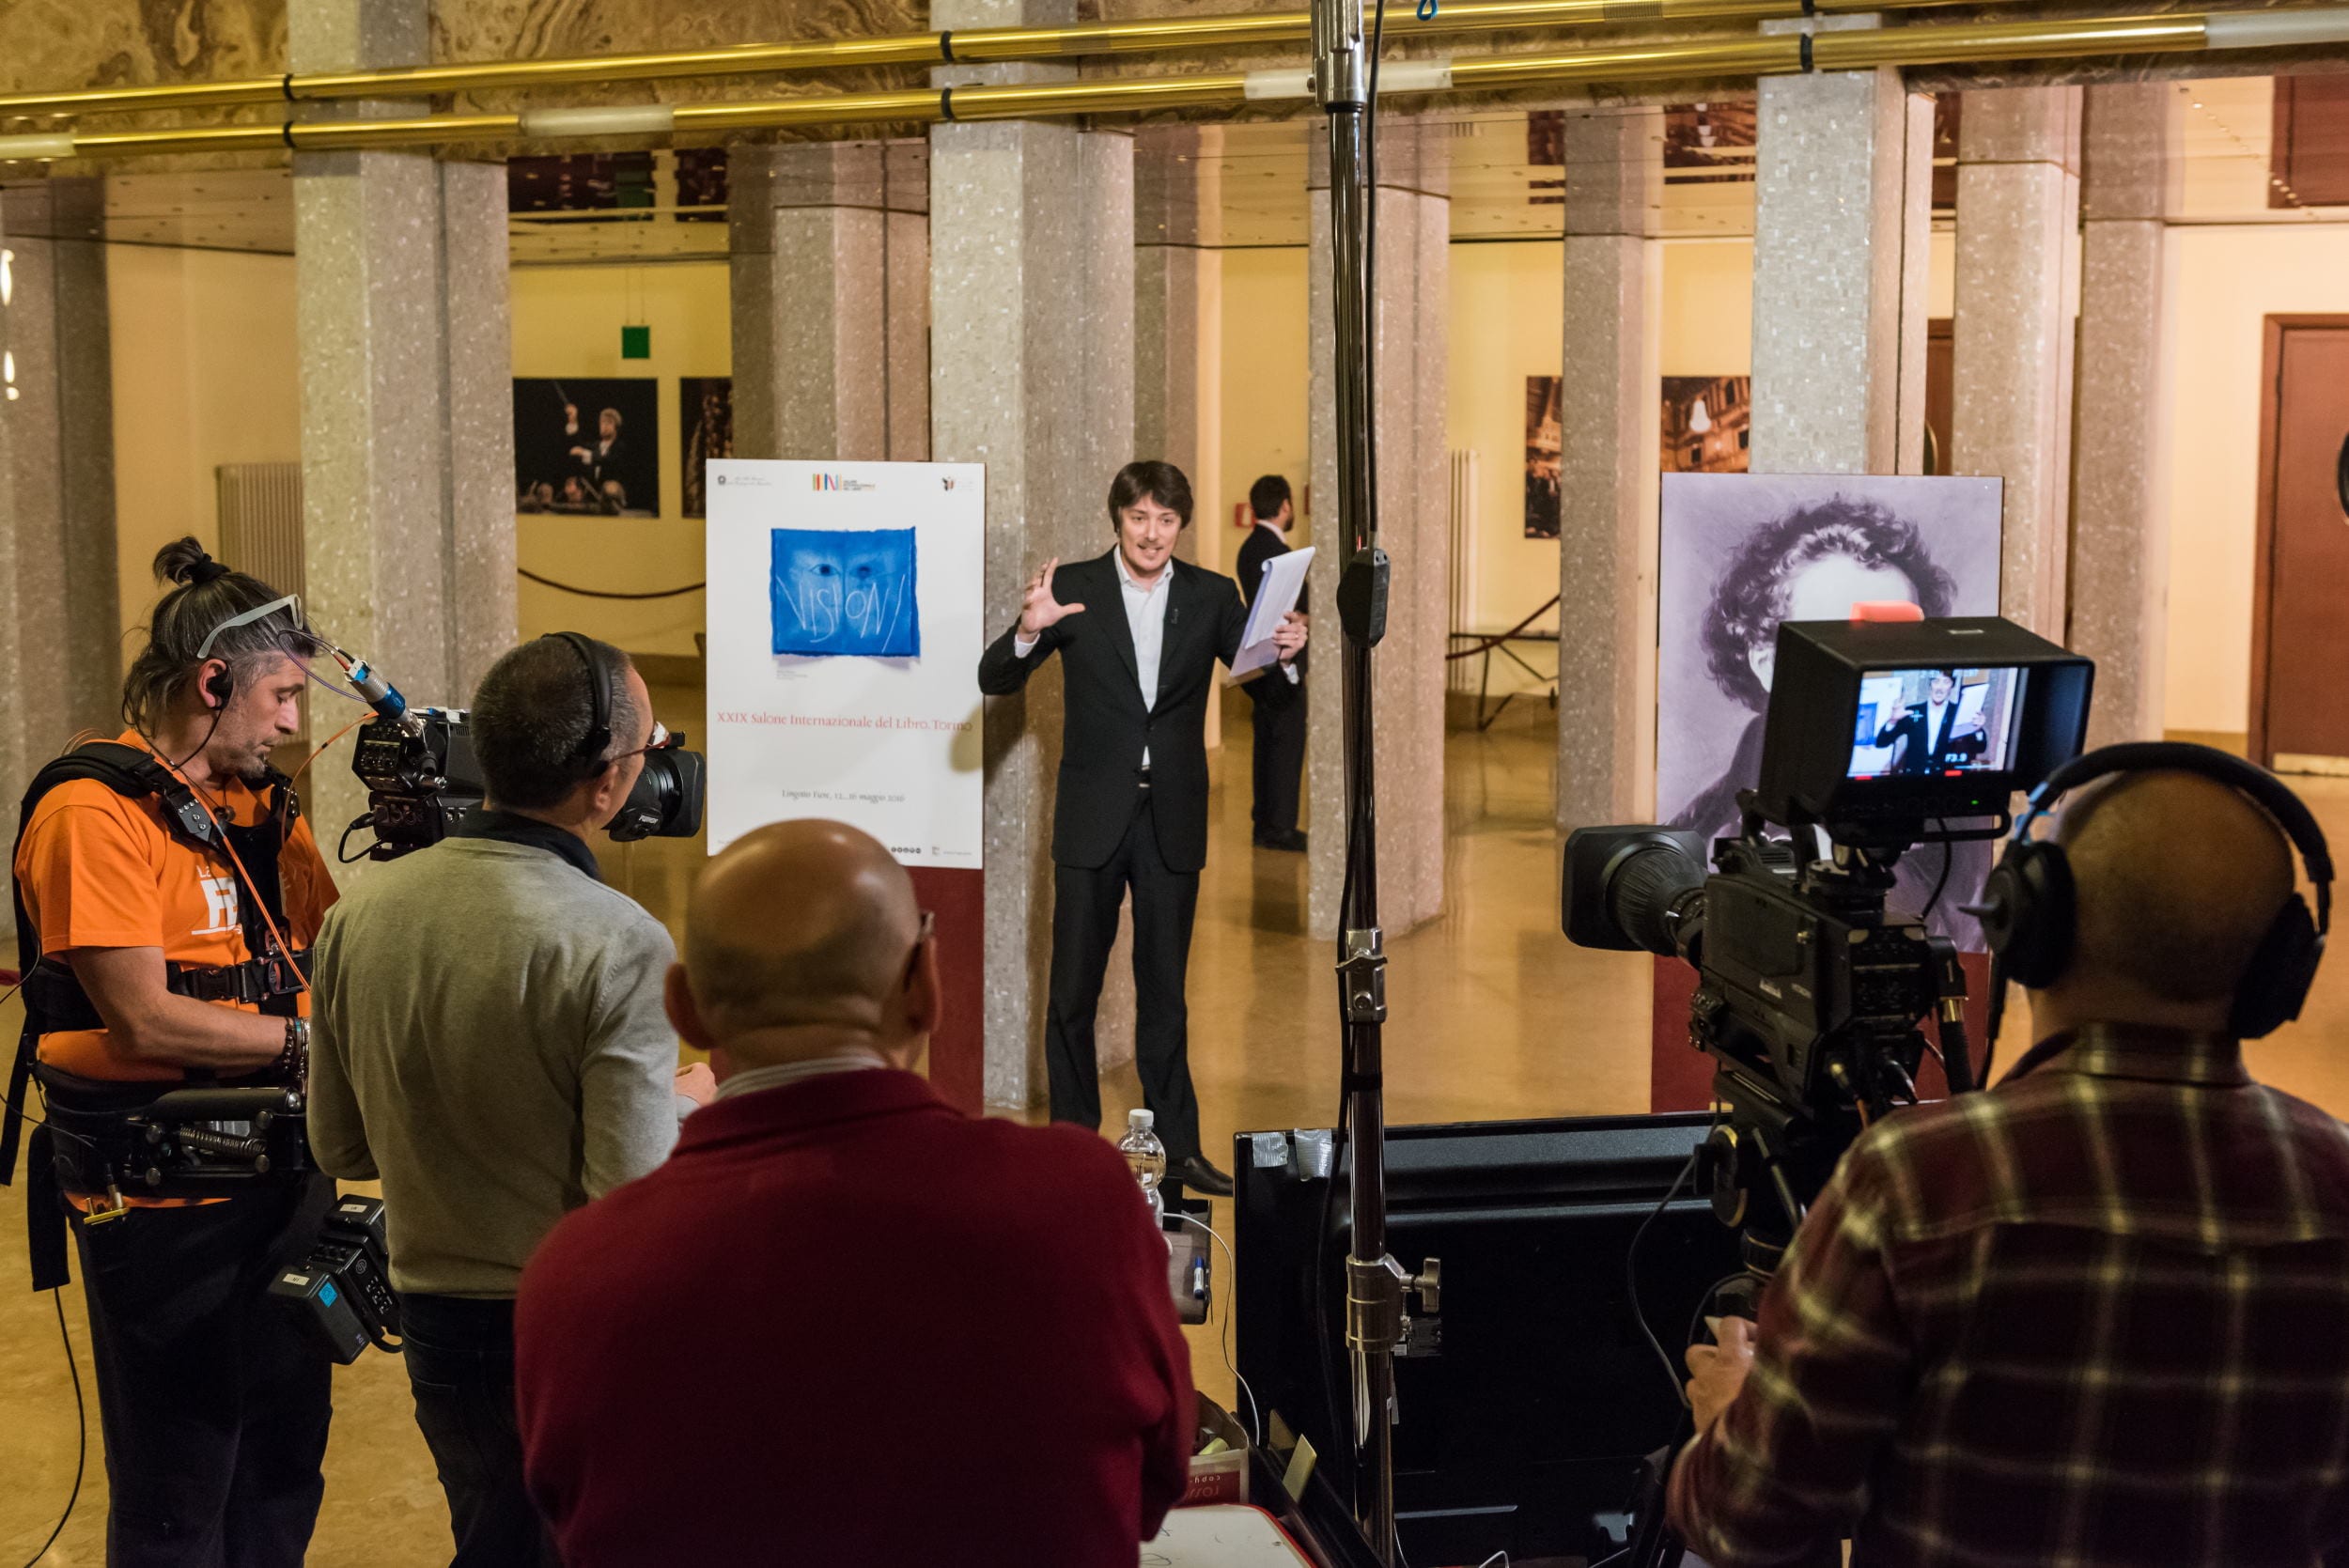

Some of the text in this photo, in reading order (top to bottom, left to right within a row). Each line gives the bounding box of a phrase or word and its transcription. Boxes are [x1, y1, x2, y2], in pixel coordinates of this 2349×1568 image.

[717, 711, 748, 723] XXIX
[751, 711, 786, 725] Salone
[790, 714, 872, 728] Internazionale
[875, 716, 893, 729] del
[932, 720, 973, 732] Torino
